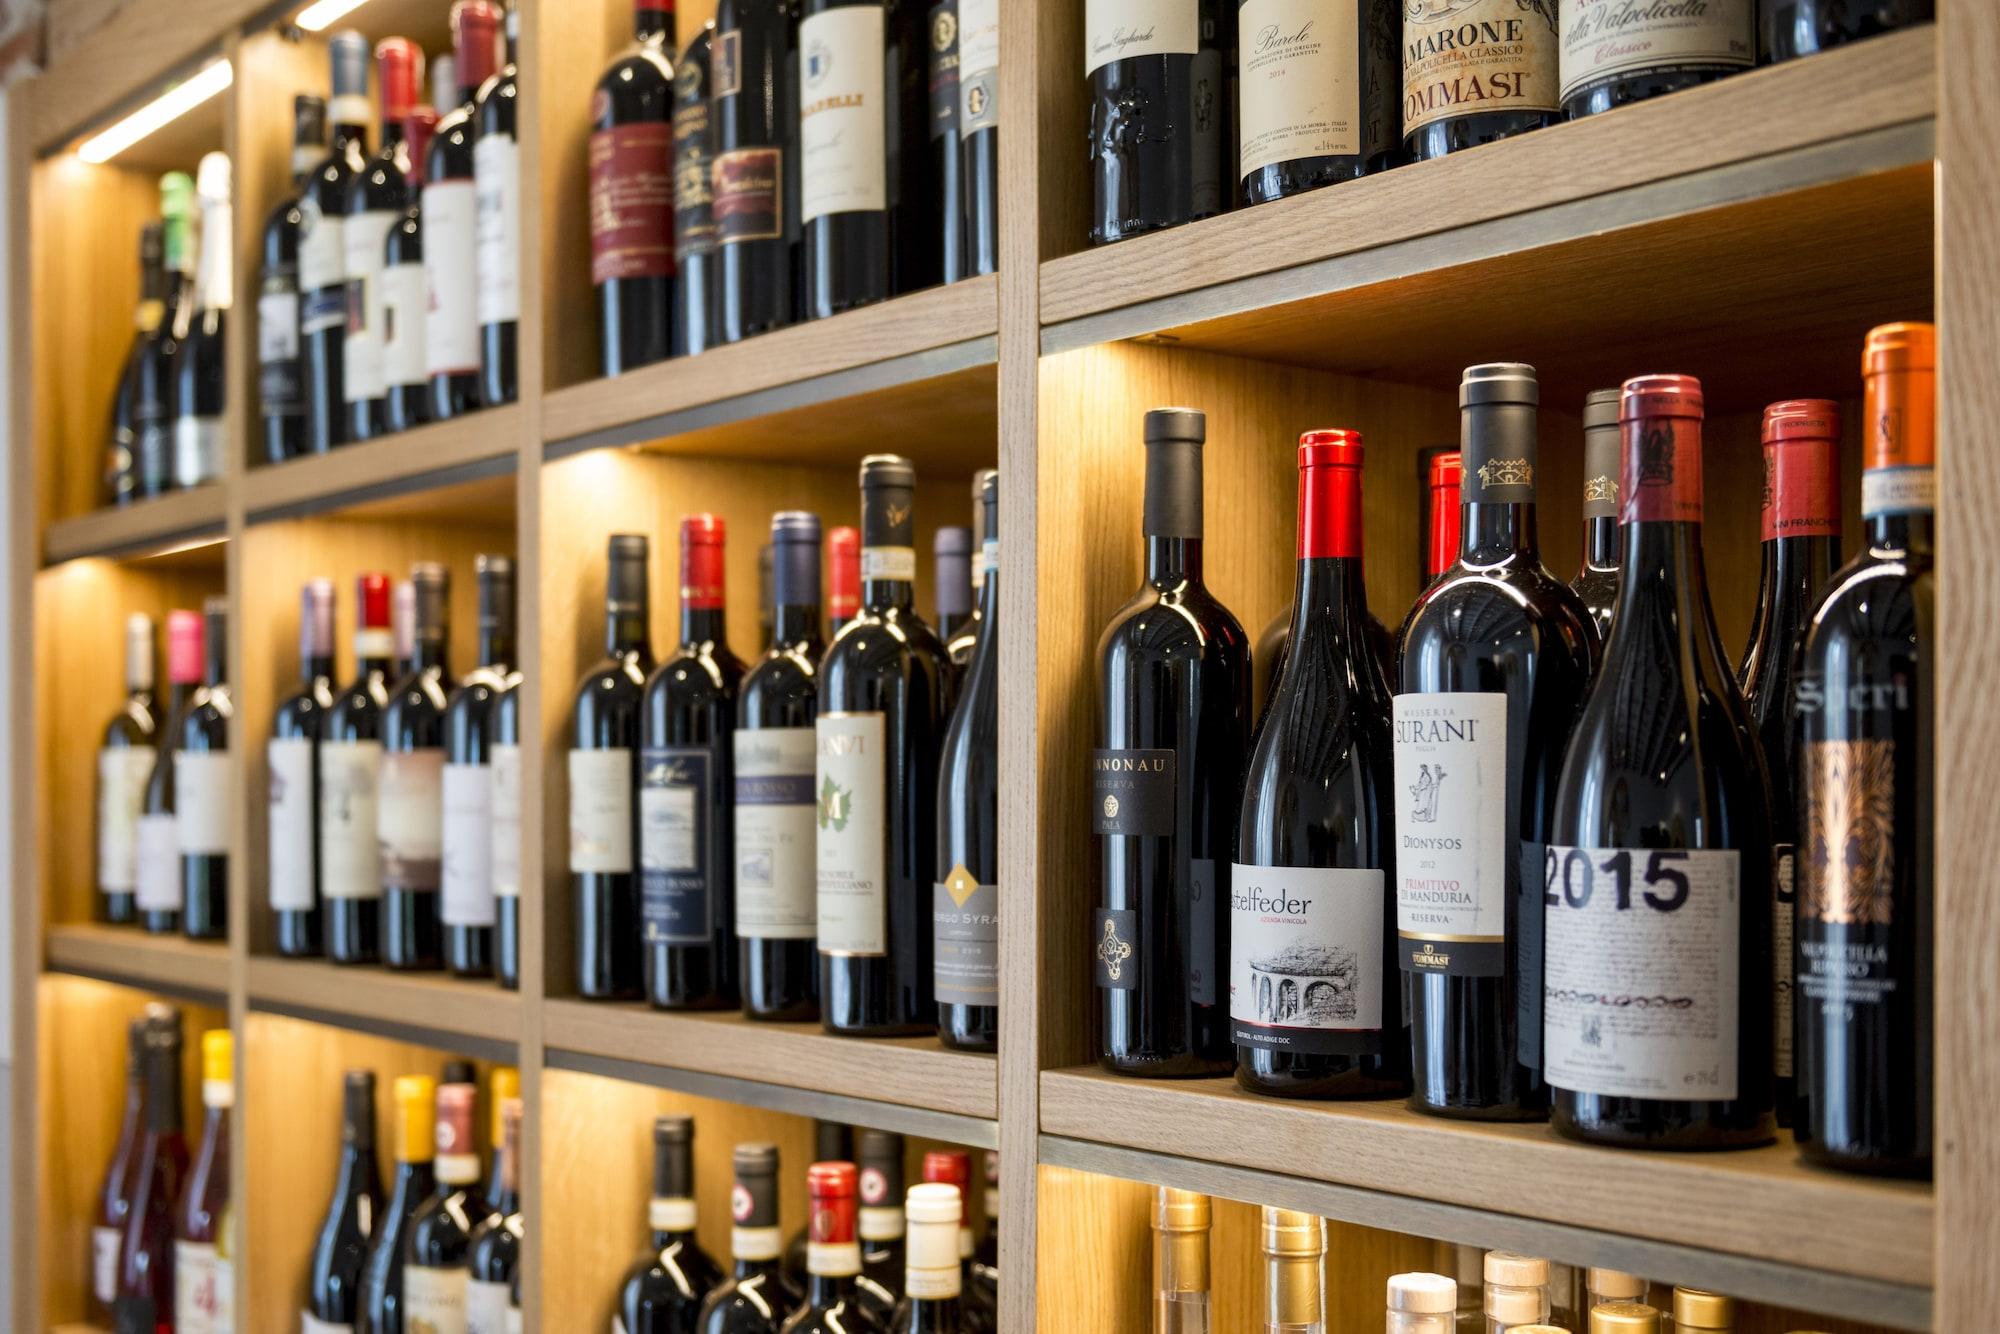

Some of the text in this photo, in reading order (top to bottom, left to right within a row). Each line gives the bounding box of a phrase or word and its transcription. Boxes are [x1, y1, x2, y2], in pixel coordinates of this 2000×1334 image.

[1564, 0, 1708, 49] della Valpolicella
[1254, 20, 1314, 55] Barolo
[1470, 44, 1523, 59] CLASSICO
[1594, 41, 1653, 64] Classico
[1404, 72, 1526, 122] OMMASI
[1772, 519, 1789, 529] VINI
[1396, 719, 1475, 744] SURANI
[1403, 835, 1462, 850] DIONYSOS
[1405, 878, 1461, 892] PRIMITIVO
[1545, 848, 1689, 912] 2015
[1409, 892, 1473, 905] MANDURIA
[1411, 913, 1450, 924] RISERVA
[1412, 953, 1449, 967] TOMMASI
[1278, 1037, 1291, 1045] DOC
